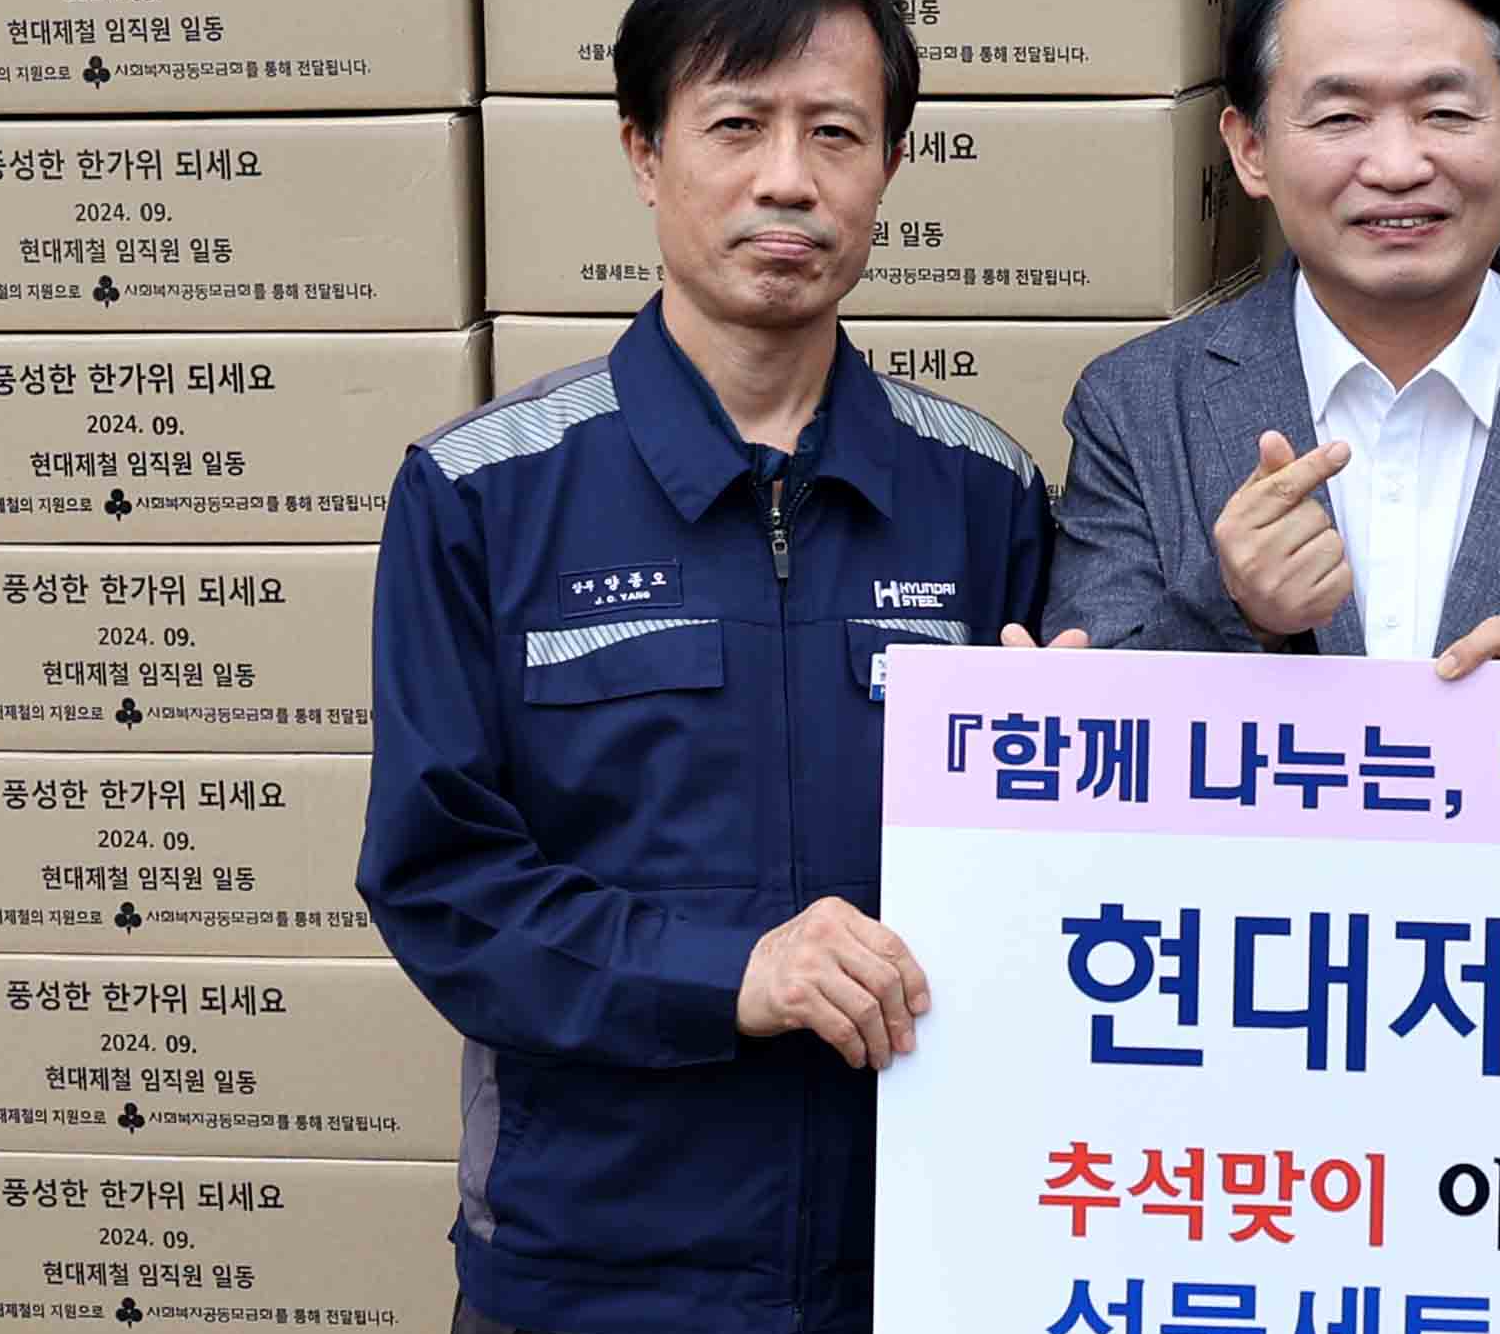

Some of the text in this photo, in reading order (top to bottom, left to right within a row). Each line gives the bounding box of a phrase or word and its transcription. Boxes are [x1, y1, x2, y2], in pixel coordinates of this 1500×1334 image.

[899, 581, 956, 595] HYUNDAI
[901, 595, 943, 607] STEEL
[1189, 721, 1462, 819] 나누는,
[5, 979, 287, 1017] 풍성한 한가위 되세요
[100, 1033, 197, 1055] 2024. 09.
[44, 1064, 258, 1096] 현대제철 임직원 일동
[51, 1108, 107, 1126] 지원으로
[294, 1114, 323, 1132] 통해
[326, 1114, 401, 1133] 전달됩니다.
[1038, 1141, 1385, 1247] 추석맞이
